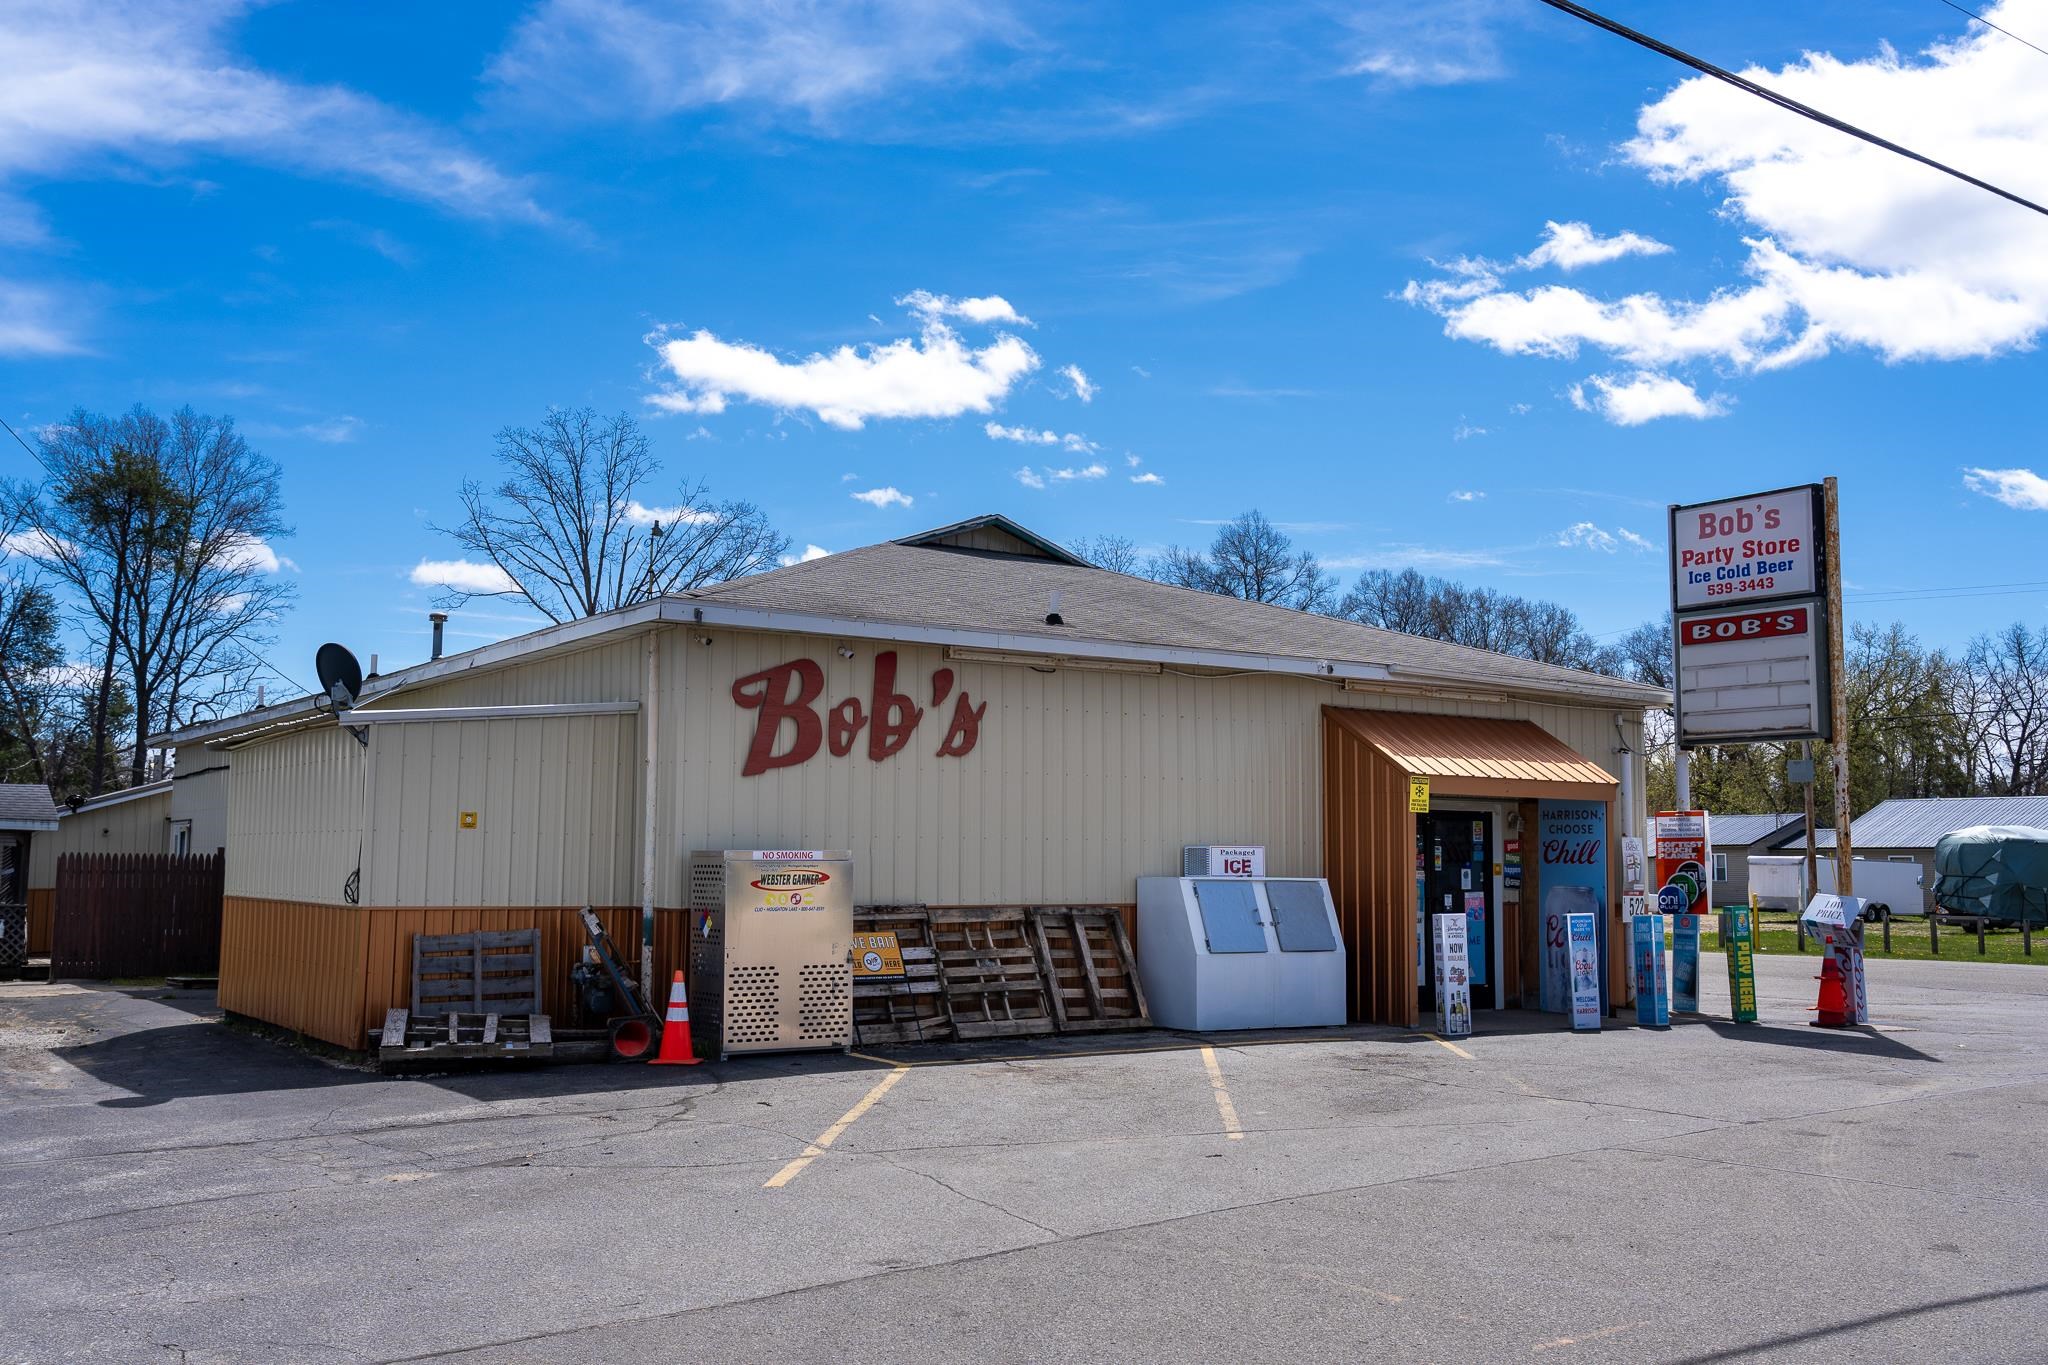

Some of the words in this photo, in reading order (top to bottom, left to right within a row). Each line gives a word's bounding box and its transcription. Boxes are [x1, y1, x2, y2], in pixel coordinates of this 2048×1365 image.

[1698, 504, 1781, 540] Bob's
[1681, 546, 1735, 568] Party
[1741, 538, 1800, 559] Store
[1688, 570, 1711, 584] Ice
[1716, 562, 1751, 581] Cold
[1757, 559, 1794, 575] Beer
[1707, 576, 1774, 595] 539-3443
[1691, 615, 1795, 640] BOB'S
[731, 651, 987, 777] Bob's
[1548, 824, 1595, 834] CHOOSE
[762, 851, 775, 859] NO
[776, 851, 814, 859] SMOKING
[1542, 839, 1601, 864] Chill
[1224, 858, 1252, 874] ICE
[760, 874, 790, 885] WEBSTER
[792, 874, 820, 885] GARNER
[1815, 908, 1844, 920] PRICE
[1824, 900, 1845, 909] LOW
[868, 936, 896, 949] BAIT
[1449, 942, 1464, 953] NOW
[1737, 941, 1752, 974] PLAY
[1738, 977, 1755, 1012] HERE
